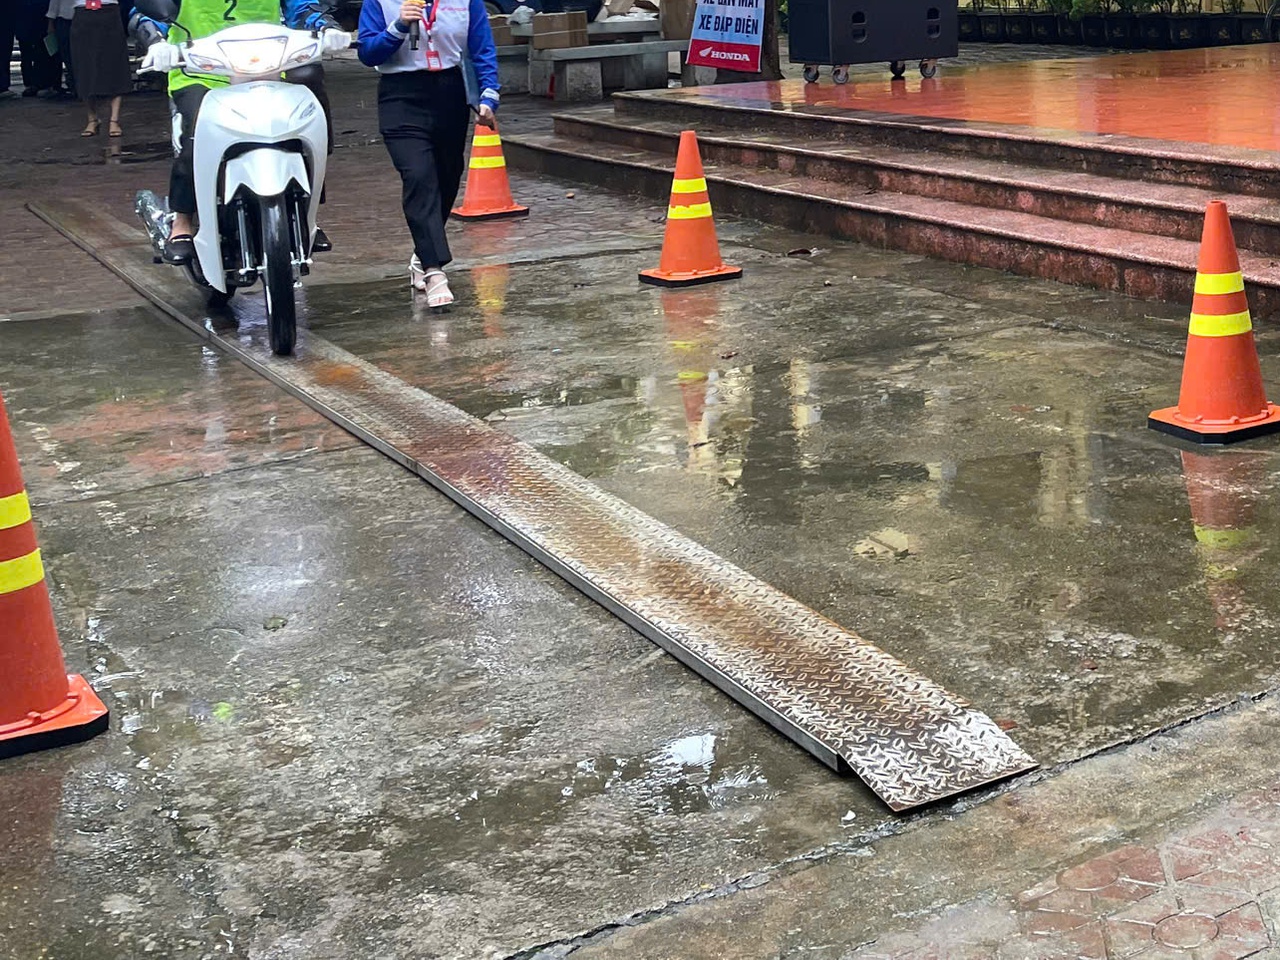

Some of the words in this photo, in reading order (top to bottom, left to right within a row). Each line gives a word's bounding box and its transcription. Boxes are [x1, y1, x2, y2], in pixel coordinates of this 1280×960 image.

[699, 14, 711, 30] XE
[713, 15, 733, 36] ĐẠP
[735, 15, 759, 38] ĐIỆN
[711, 51, 750, 62] HONDA
